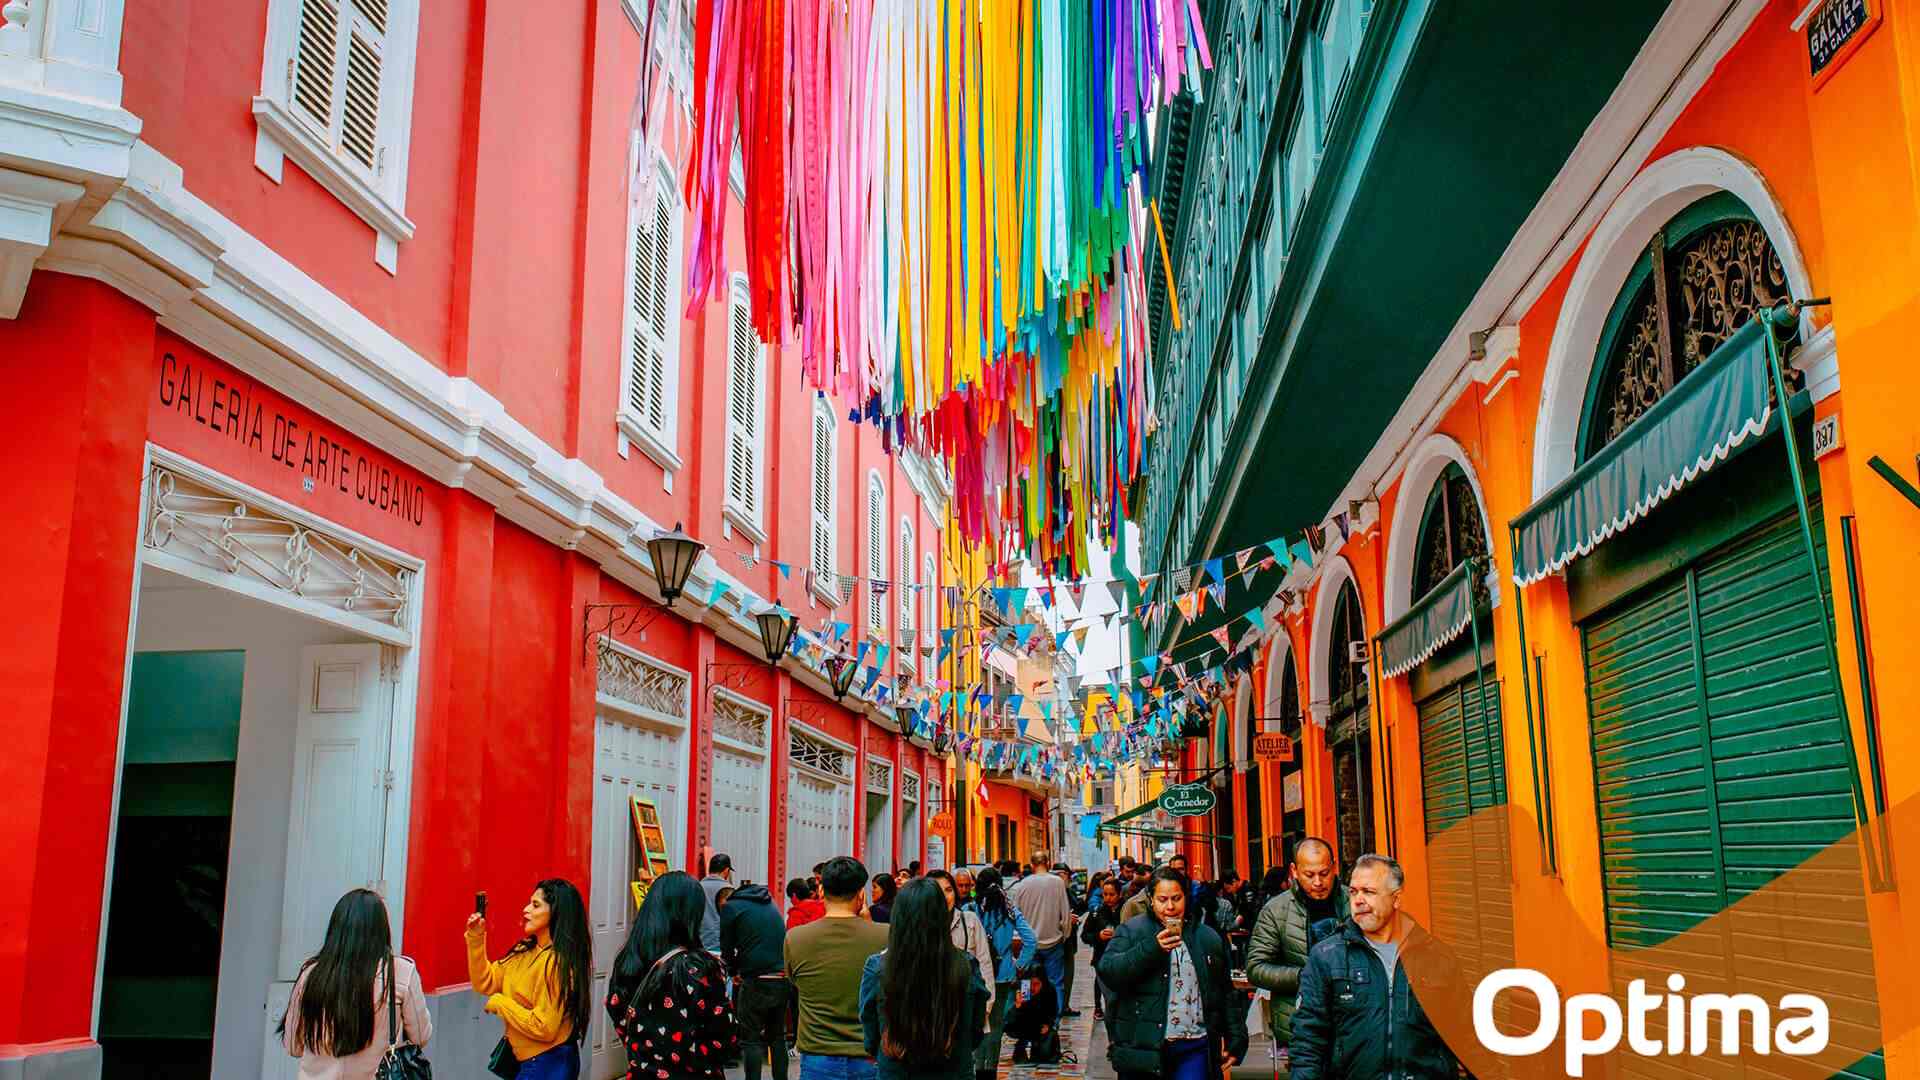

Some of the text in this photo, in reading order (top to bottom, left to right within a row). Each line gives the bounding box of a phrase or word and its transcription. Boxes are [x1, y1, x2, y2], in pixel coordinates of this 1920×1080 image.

[1830, 15, 1856, 50] CALLE
[159, 352, 424, 526] GALERÍA DE ARTE CUBANO
[1256, 737, 1289, 750] ATELIER
[1164, 796, 1209, 809] Comedor
